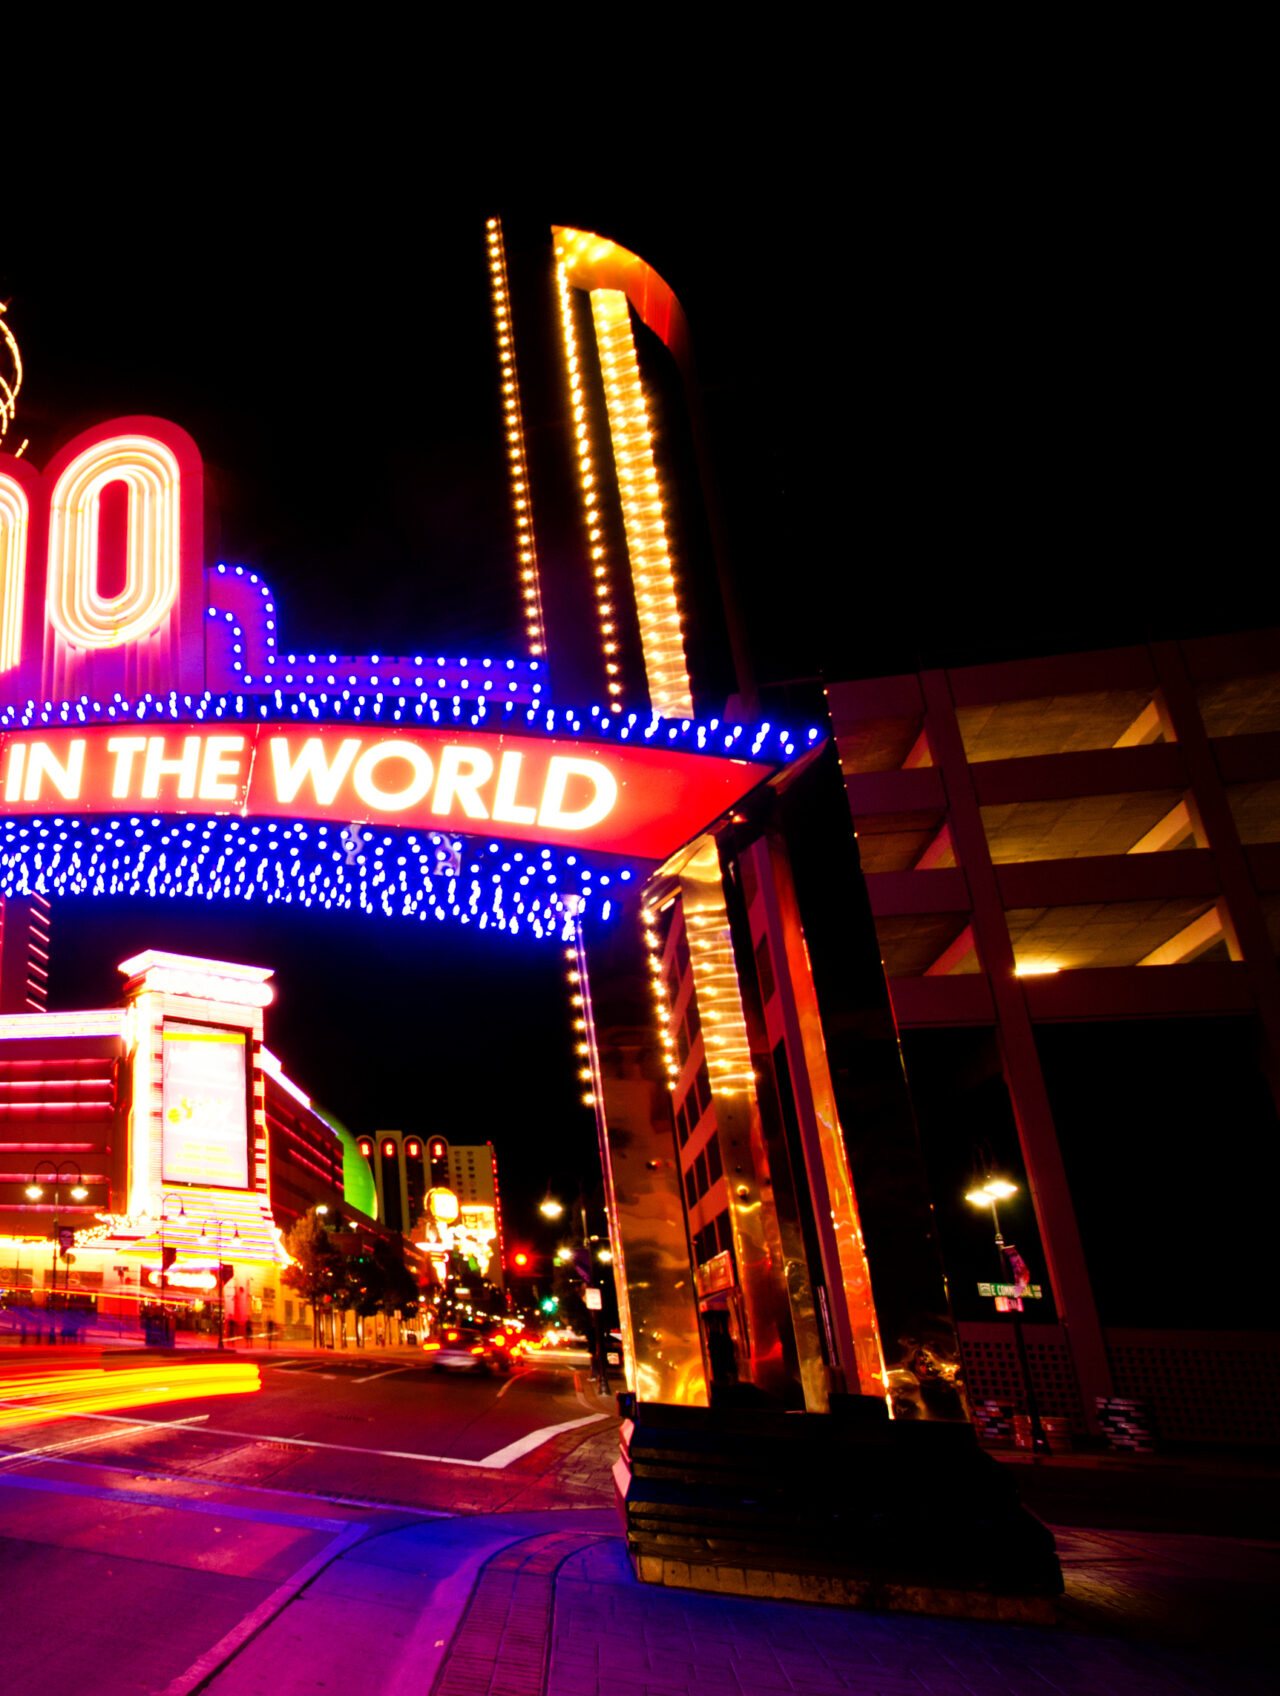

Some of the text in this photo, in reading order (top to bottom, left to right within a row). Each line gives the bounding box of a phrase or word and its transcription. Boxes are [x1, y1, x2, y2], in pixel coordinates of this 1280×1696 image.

[4, 739, 85, 802] IN
[108, 736, 245, 799] THE
[270, 738, 618, 831] WORLD
